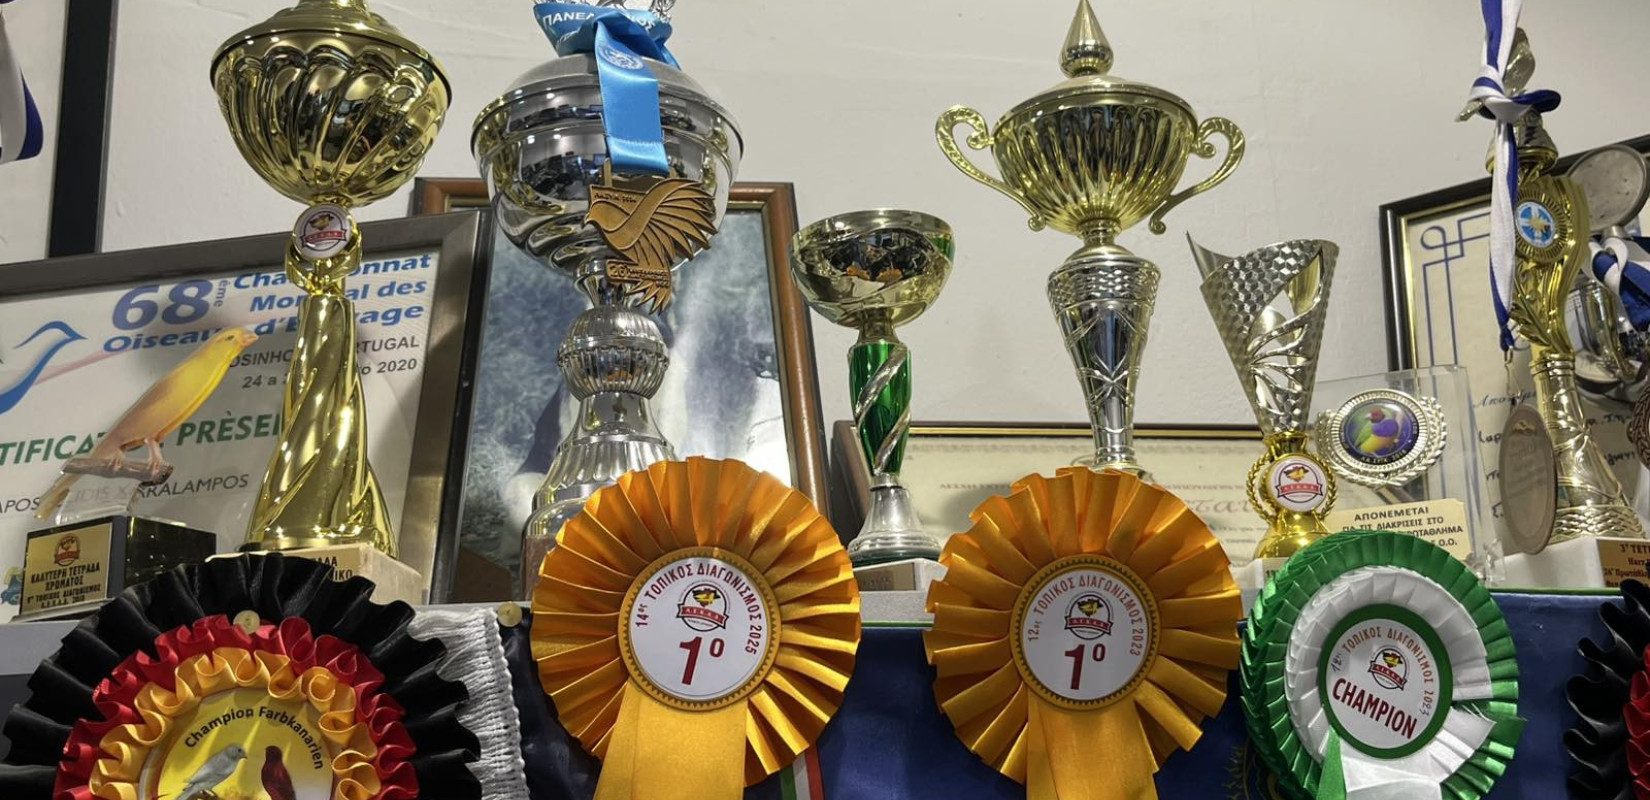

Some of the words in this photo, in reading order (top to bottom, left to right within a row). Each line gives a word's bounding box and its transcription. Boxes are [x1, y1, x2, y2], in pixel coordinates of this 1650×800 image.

[542, 11, 595, 29] ΠΑΝΕΛ
[112, 279, 214, 331] 68
[377, 281, 427, 297] des
[103, 328, 222, 352] Oiseau
[357, 335, 420, 354] TUGAL
[242, 375, 262, 389] 24
[267, 376, 278, 386] a
[377, 358, 417, 374] 2020
[0, 431, 107, 467] TIFICA
[176, 409, 280, 446] PRÈSE
[1354, 506, 1429, 522] ΑΠΟΝΕΜΕΤΑΙ
[1427, 516, 1444, 525] ΣΤΟ
[645, 563, 694, 600] ΤΟΠΙΚΟΣ
[697, 562, 762, 620] ΔΙΑΓΩΝΙΣΜΟΣ
[744, 625, 762, 655] 2025
[1033, 576, 1076, 615] ΤΟΠΙΚΟΣ
[1078, 574, 1143, 625] ΔΙΑΓΩΝΙΣΜΟΣ
[1129, 628, 1144, 656] 2023
[1342, 626, 1382, 653] ΤΟΠΙΚΟΣ
[1386, 627, 1434, 684] ΔΙΑΓΩΝΙΣΜΟΣ
[1332, 677, 1418, 740] CHAMPION
[185, 708, 254, 748] Champion
[258, 706, 324, 770] Farbkanarien
